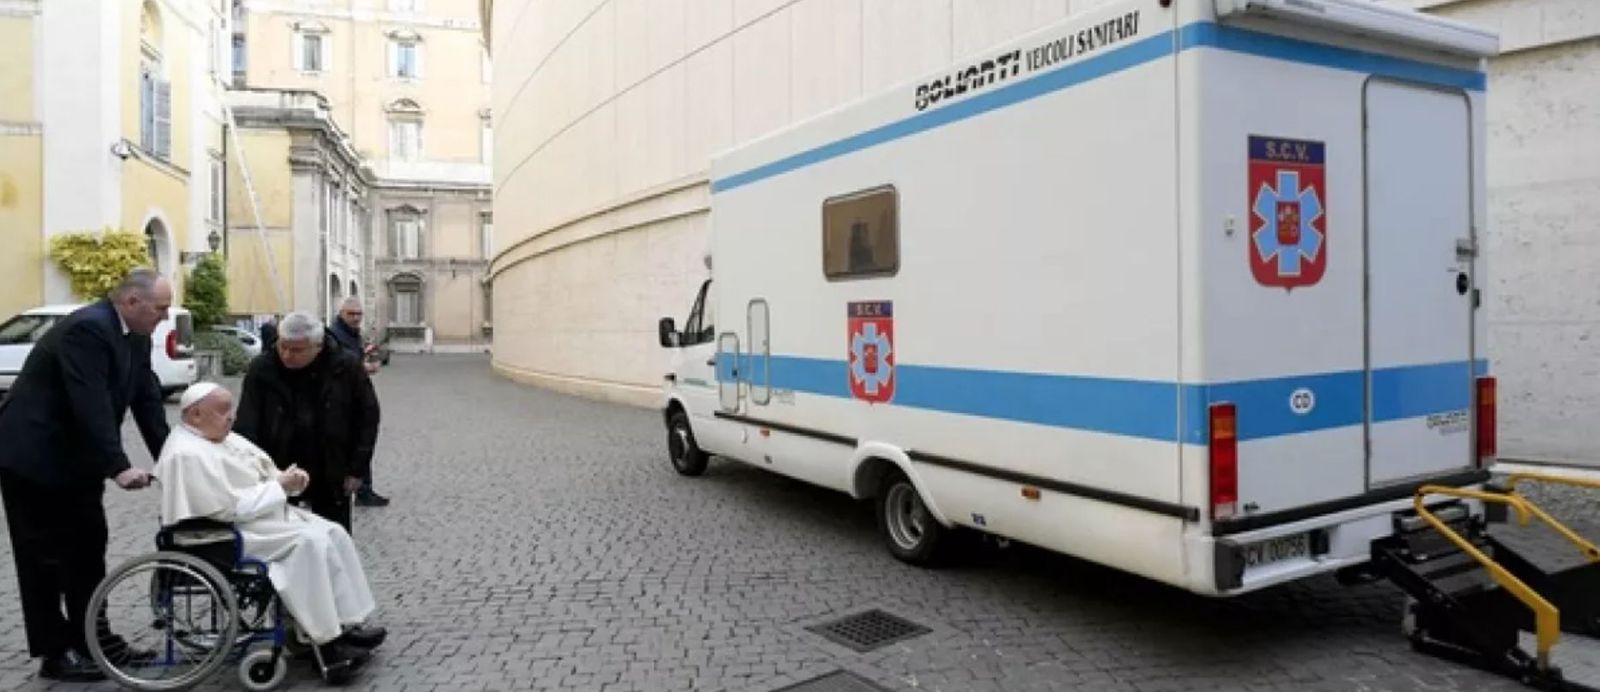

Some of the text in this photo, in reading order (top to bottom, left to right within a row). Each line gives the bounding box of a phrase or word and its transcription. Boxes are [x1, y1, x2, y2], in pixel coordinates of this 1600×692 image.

[1026, 35, 1074, 72] VEICOLI
[1076, 10, 1140, 54] SANITARI
[1265, 140, 1310, 162] S.C.V.
